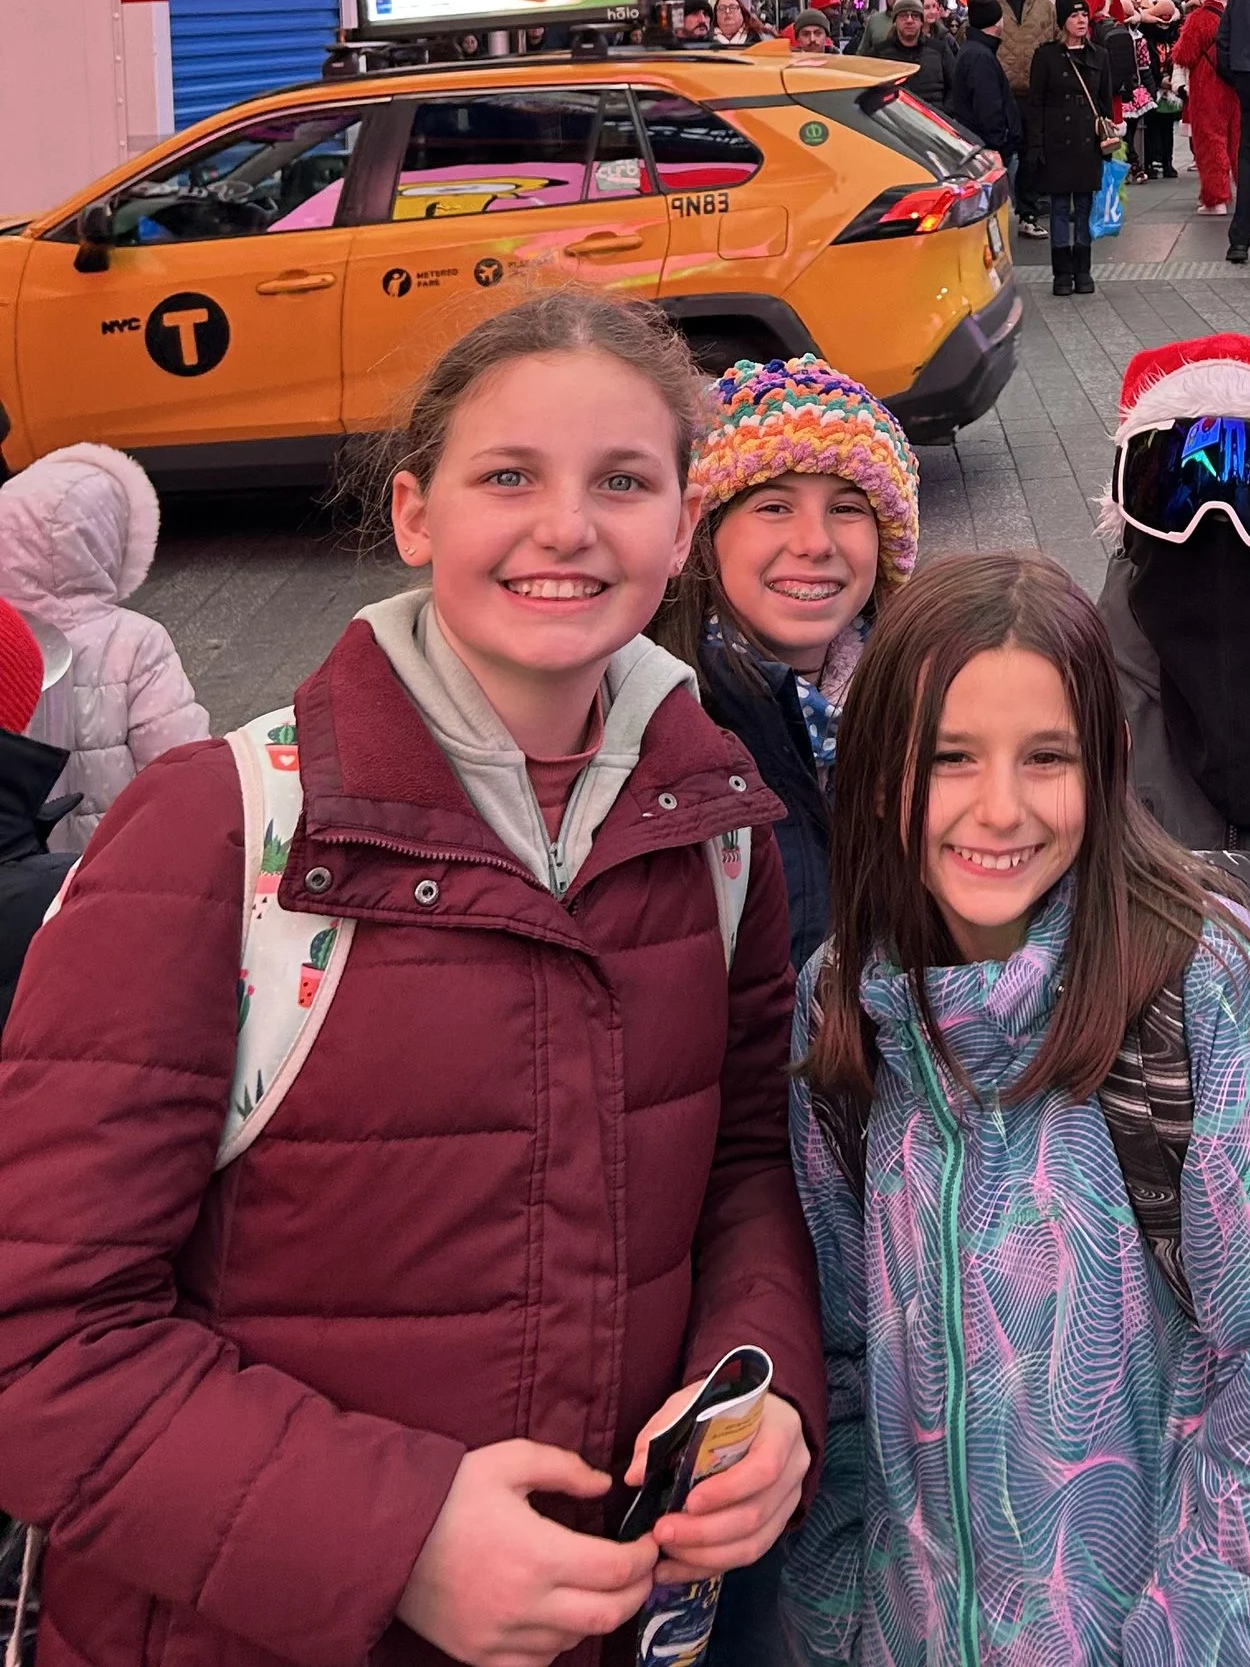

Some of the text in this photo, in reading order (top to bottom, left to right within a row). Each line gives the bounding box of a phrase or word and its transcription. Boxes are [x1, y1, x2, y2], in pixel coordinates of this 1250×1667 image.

[672, 192, 730, 218] 9N83
[416, 268, 458, 279] METERED
[417, 280, 441, 288] FARE
[101, 309, 209, 366] NYC T
